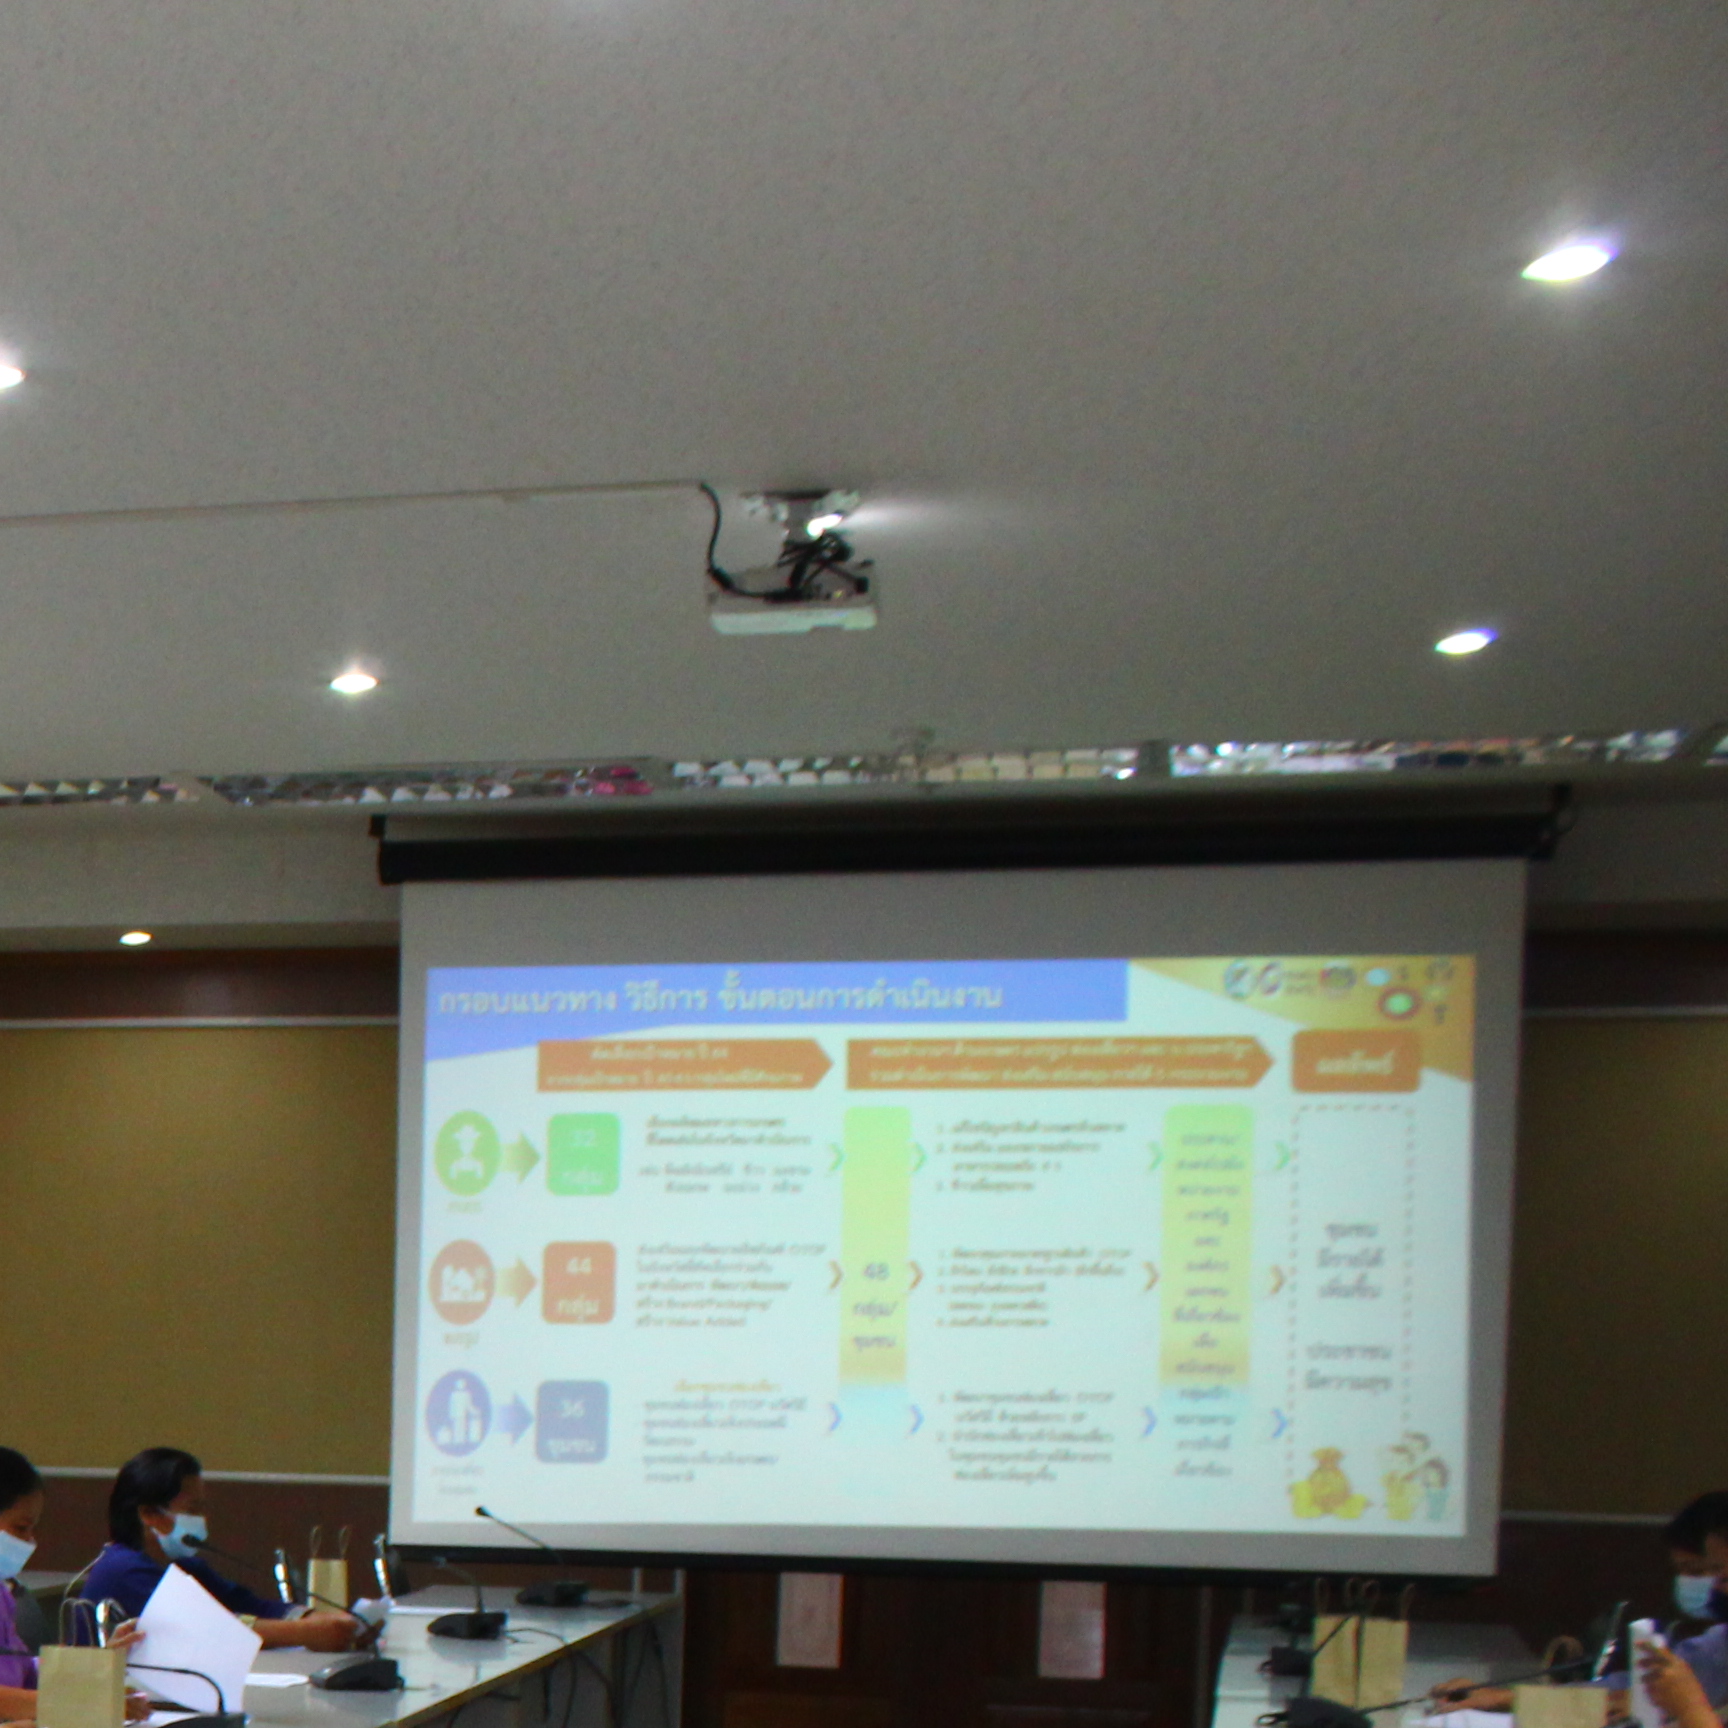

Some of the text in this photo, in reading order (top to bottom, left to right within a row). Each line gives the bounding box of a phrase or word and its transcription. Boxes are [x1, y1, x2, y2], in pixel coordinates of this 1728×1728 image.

[439, 970, 1002, 1015] กรอบแนวทาง วิธีการ ขั้นตอนการดำเนินงาน
[566, 1258, 592, 1275] 44
[556, 1295, 600, 1323] กลุ่ม
